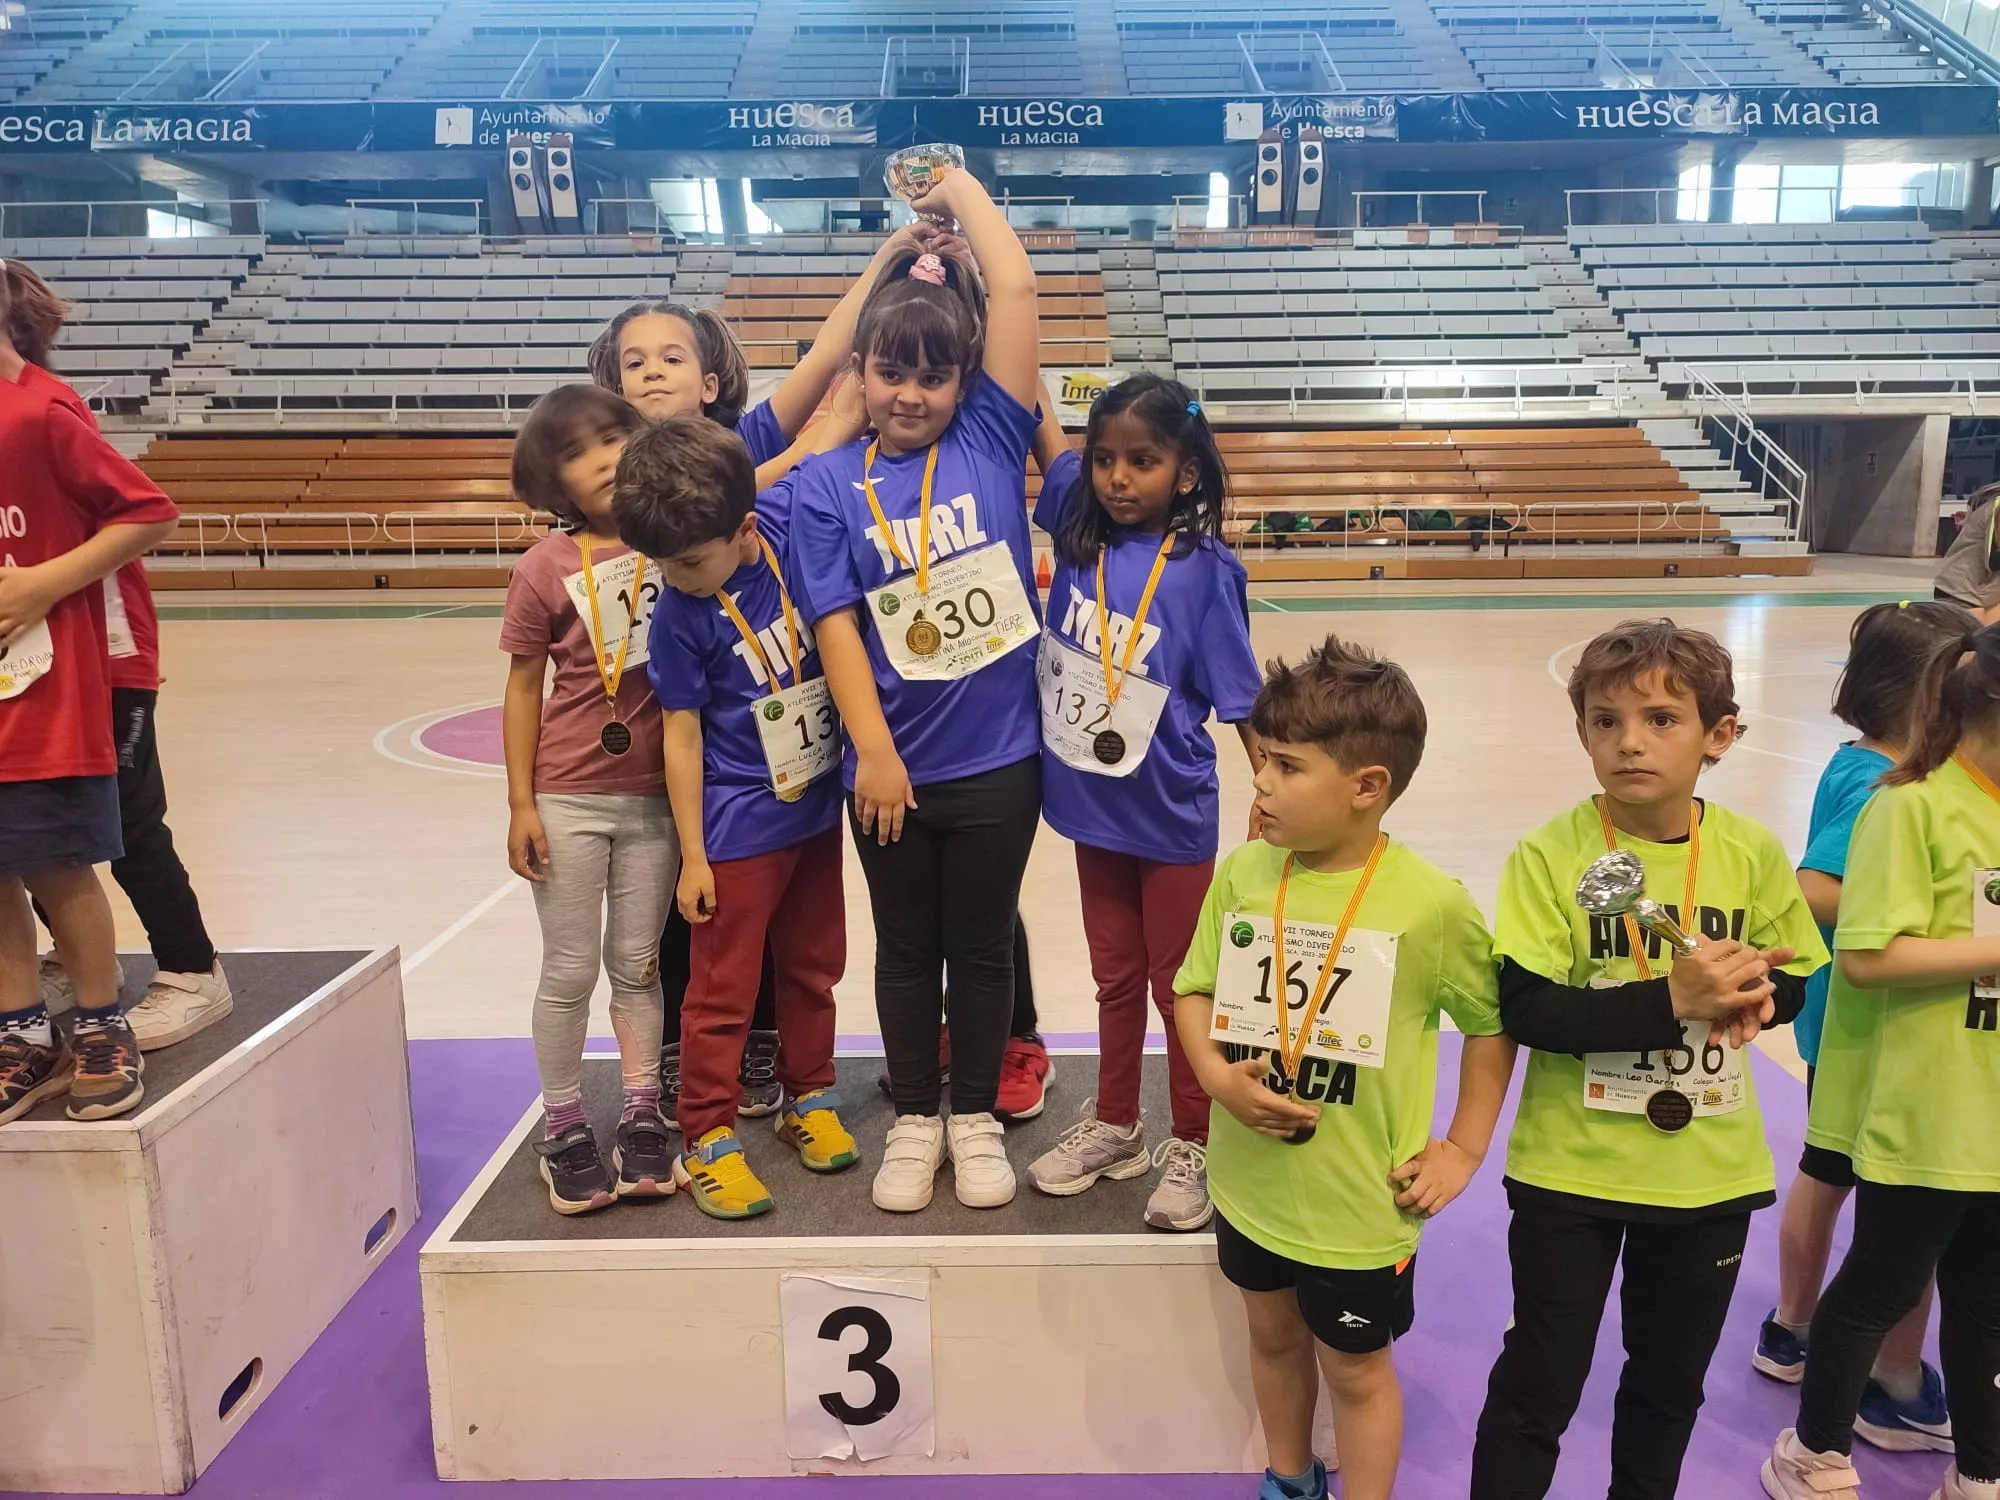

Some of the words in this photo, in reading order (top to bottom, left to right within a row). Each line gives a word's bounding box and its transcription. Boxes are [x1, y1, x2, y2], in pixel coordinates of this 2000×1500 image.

[479, 107, 605, 128] Ayuntamiento
[1270, 100, 1395, 121] Ayuntamiento
[479, 128, 500, 145] de
[1061, 382, 1102, 400] Inte
[0, 505, 27, 538] IO
[864, 493, 987, 575] TIERZ
[602, 568, 636, 585] ATLETISM
[1061, 583, 1161, 675] TIERZ
[732, 607, 816, 687] TIE
[1054, 686, 1112, 737] 132
[1257, 934, 1304, 947] ATLESMO
[1283, 926, 1297, 935] VII
[1300, 928, 1335, 940] TORNEO
[1253, 956, 1352, 1015] 167
[1626, 1072, 1642, 1082] Leo
[817, 1306, 900, 1426] 3
